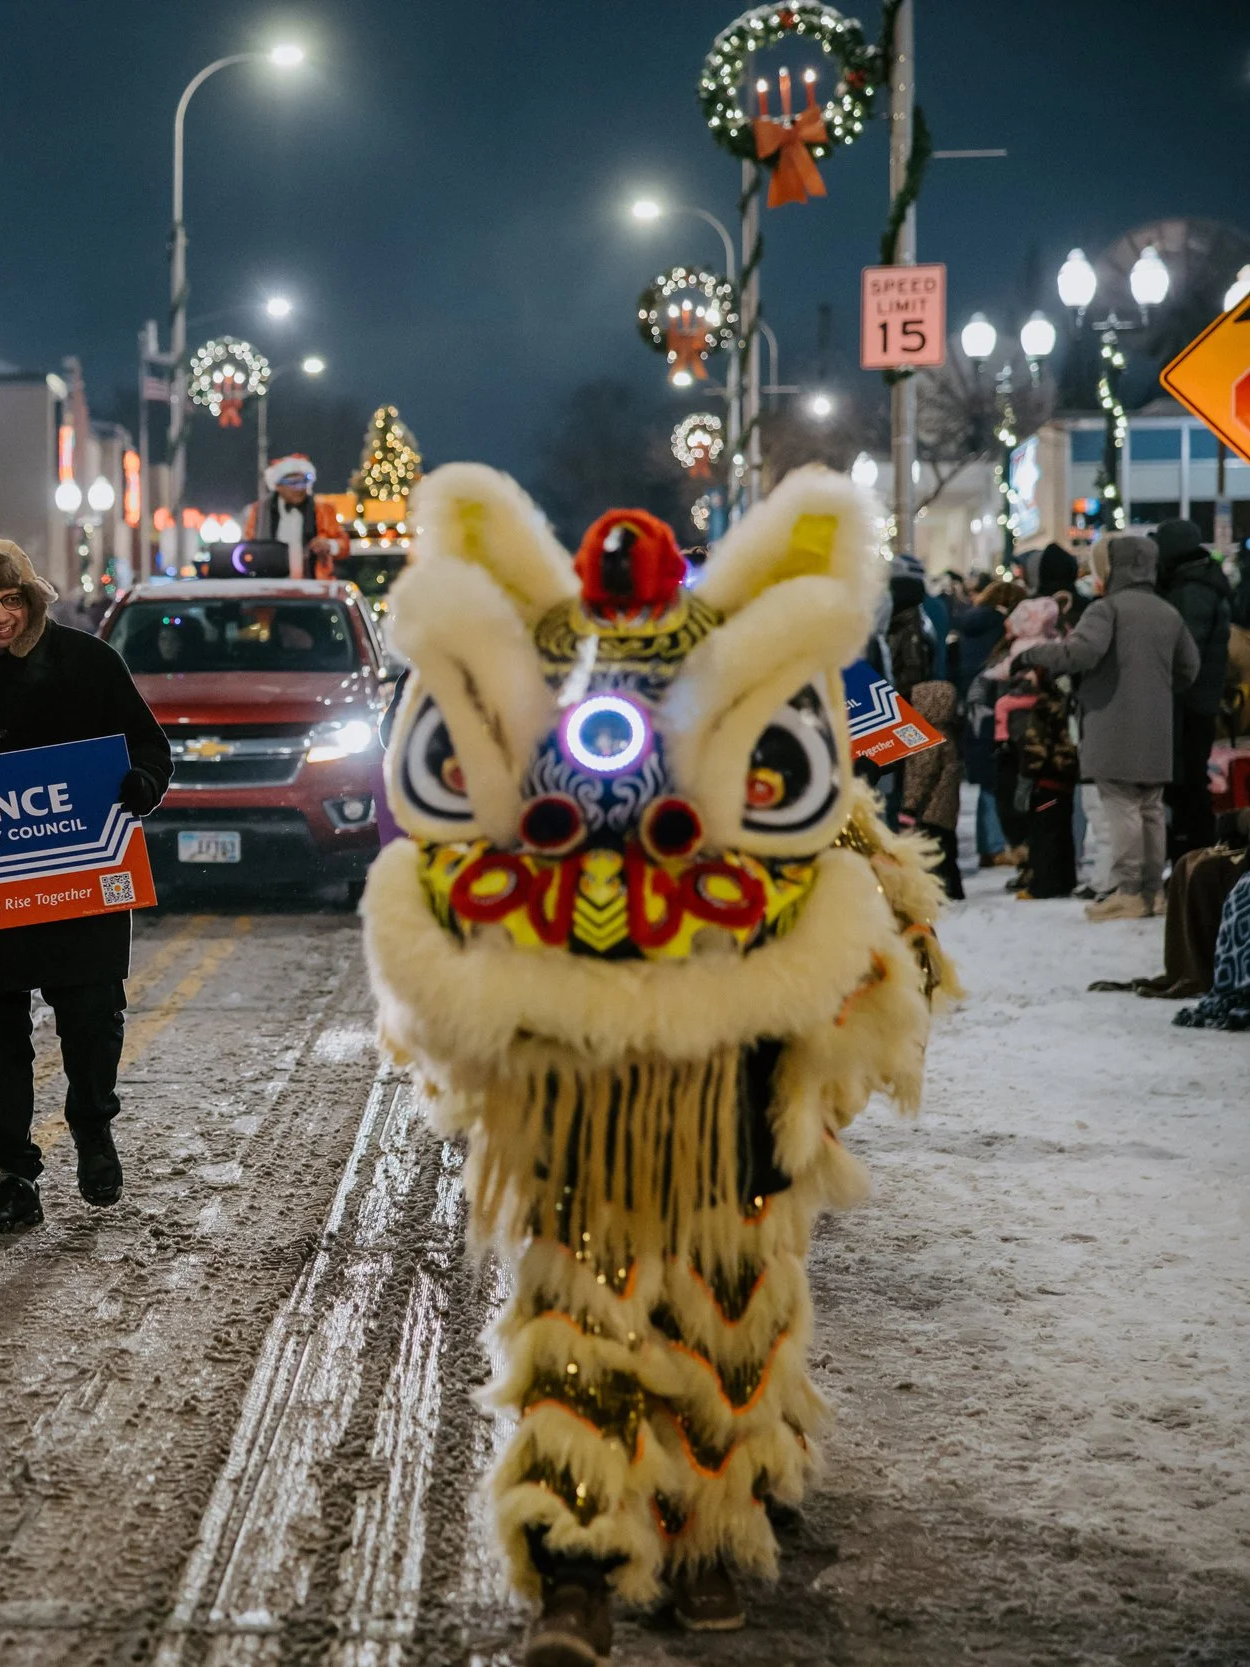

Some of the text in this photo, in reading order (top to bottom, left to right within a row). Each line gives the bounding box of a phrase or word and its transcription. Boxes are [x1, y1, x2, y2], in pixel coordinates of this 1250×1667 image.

[871, 277, 936, 296] SPEED
[877, 298, 927, 316] LIMIT
[878, 320, 926, 353] 15
[7, 819, 87, 841] COUNCIL
[5, 896, 31, 910] Rise
[35, 887, 93, 906] Together
